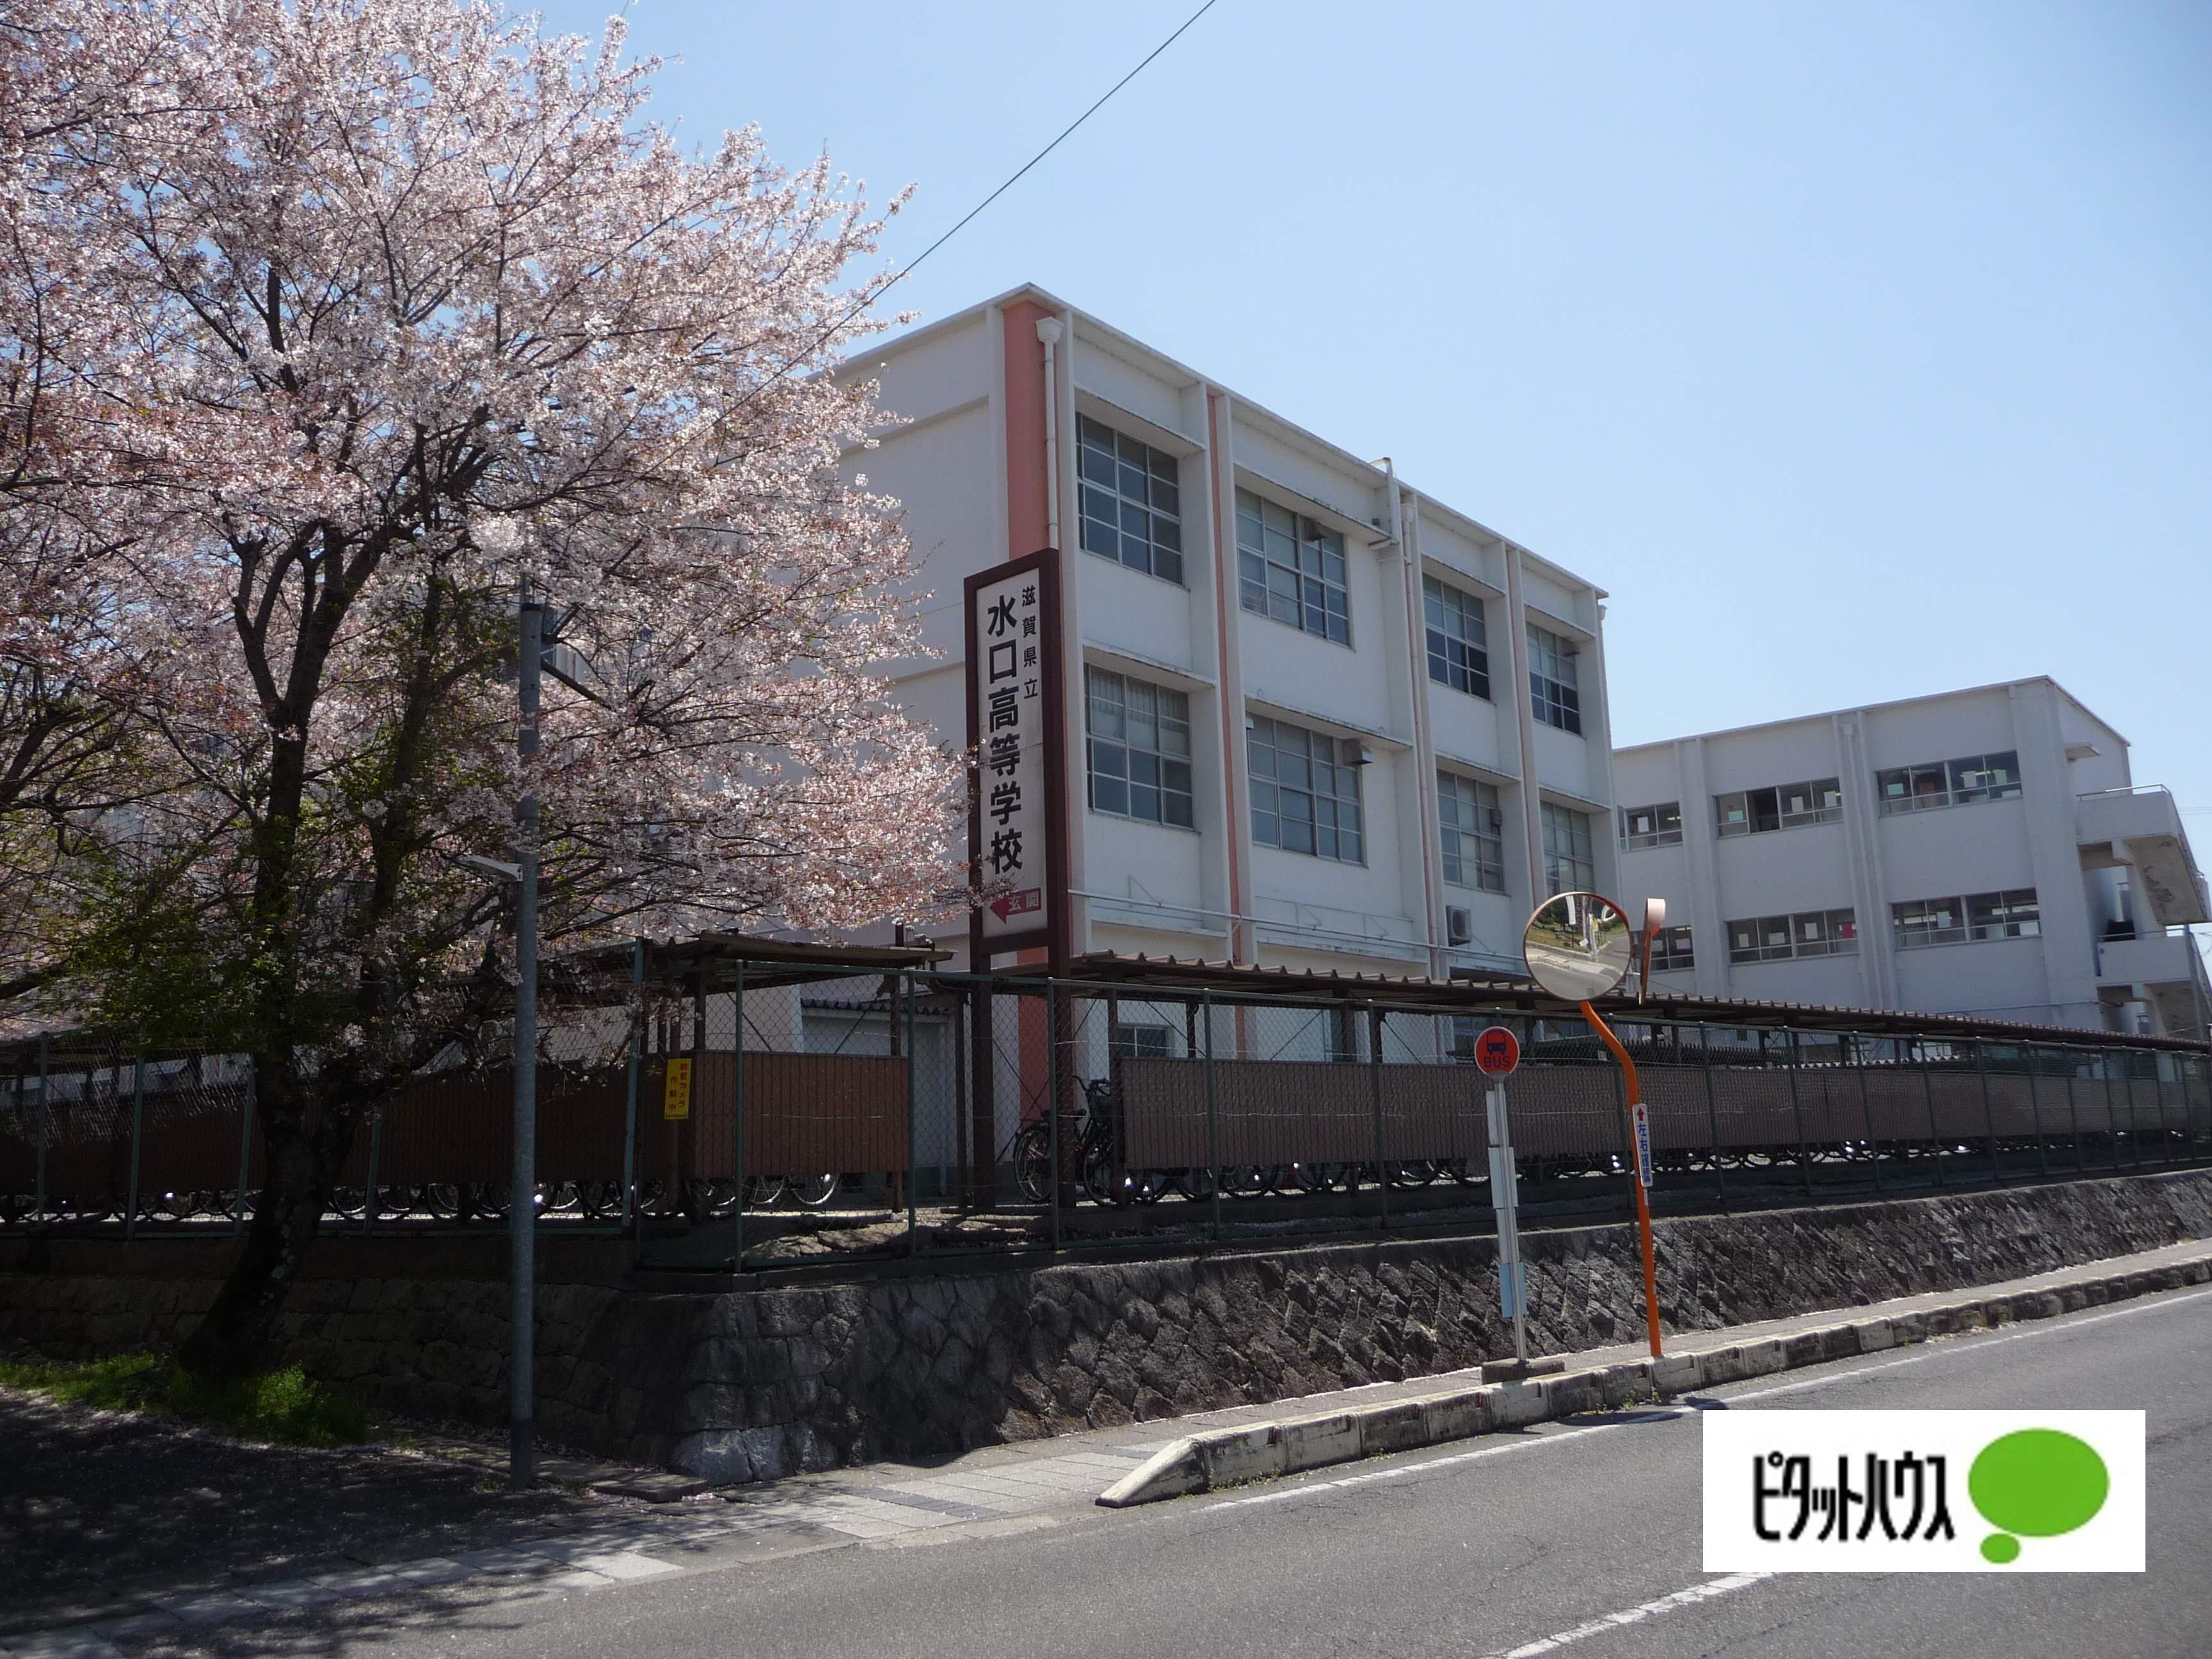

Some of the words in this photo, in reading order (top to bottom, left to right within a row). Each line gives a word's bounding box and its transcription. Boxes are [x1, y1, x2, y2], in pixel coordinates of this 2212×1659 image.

[1022, 586, 1038, 700] 滋賀県立
[987, 595, 1023, 875] 水口高等学校
[1008, 890, 1039, 912] 玄関
[1484, 1055, 1511, 1068] BUS
[678, 1062, 688, 1108] 防犯カメラ
